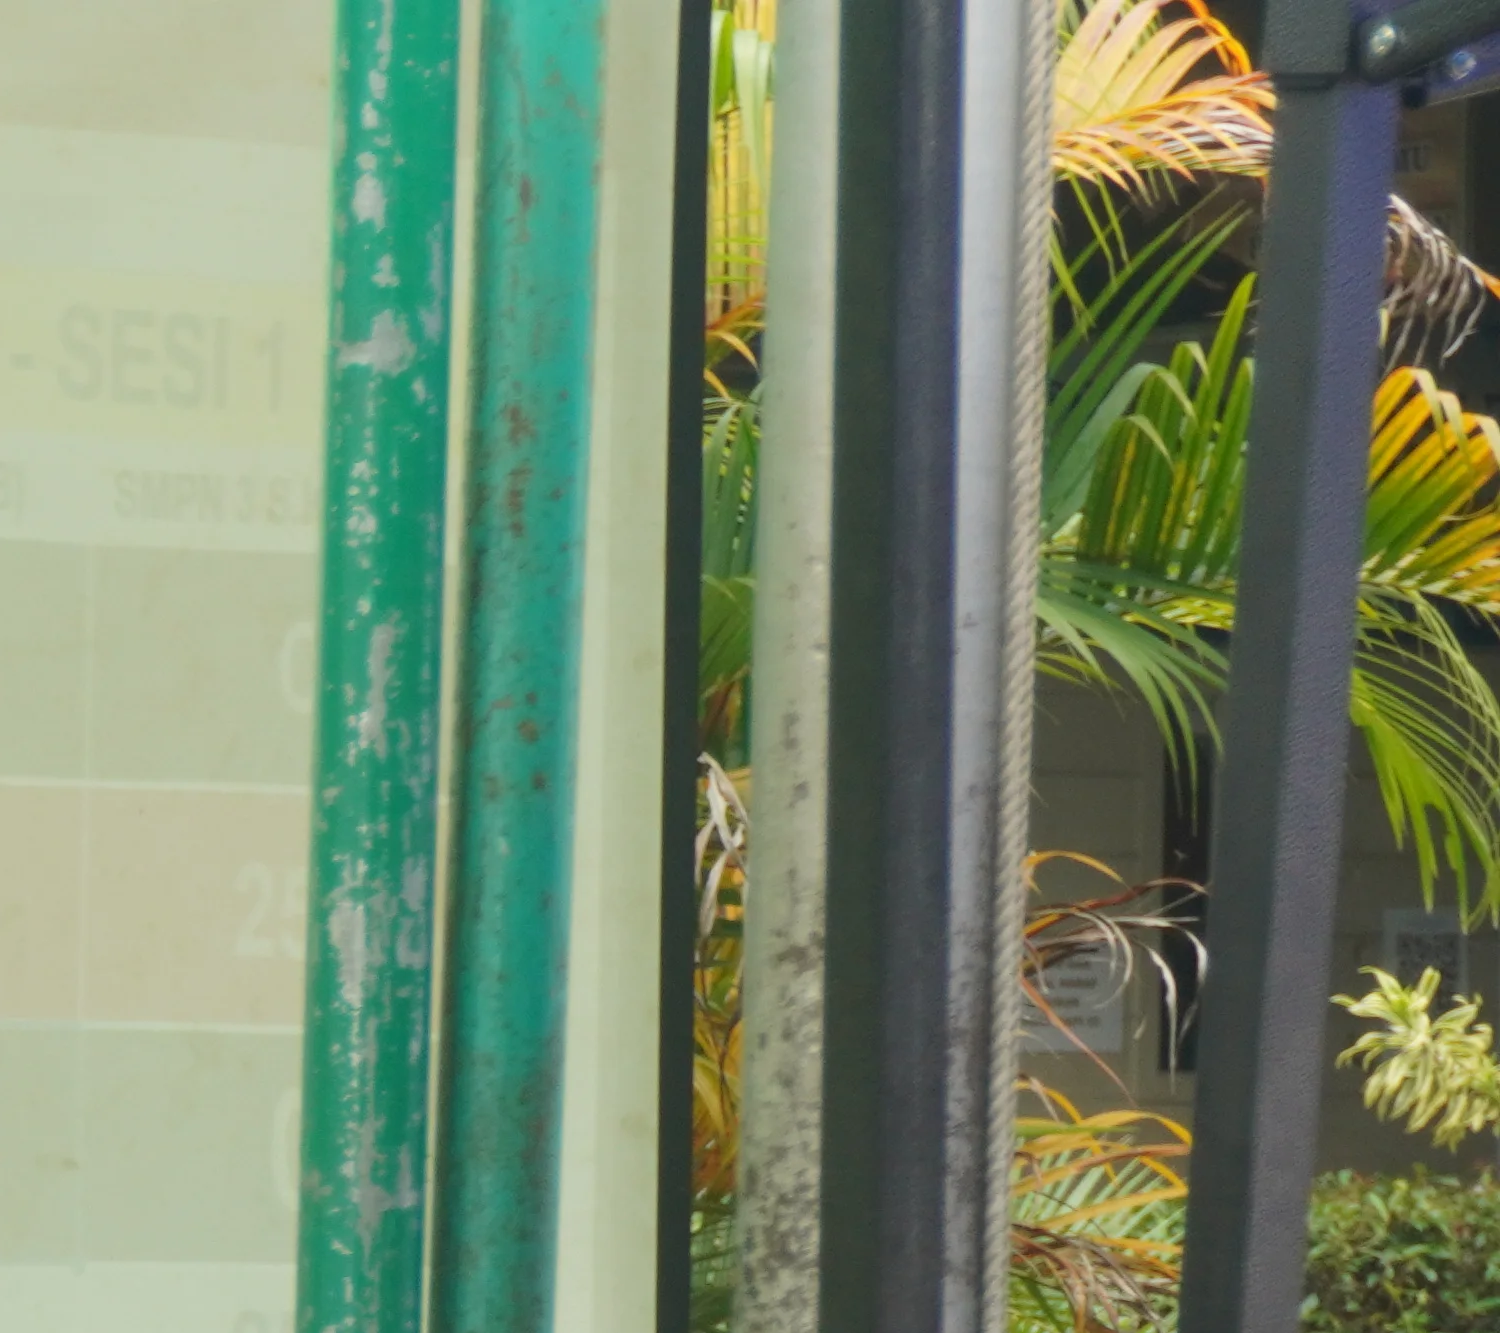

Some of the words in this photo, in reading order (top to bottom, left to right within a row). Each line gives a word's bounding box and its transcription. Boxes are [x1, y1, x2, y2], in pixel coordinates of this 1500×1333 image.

[56, 302, 229, 408] SESI
[251, 318, 286, 407] 1
[113, 467, 229, 526] SMPN
